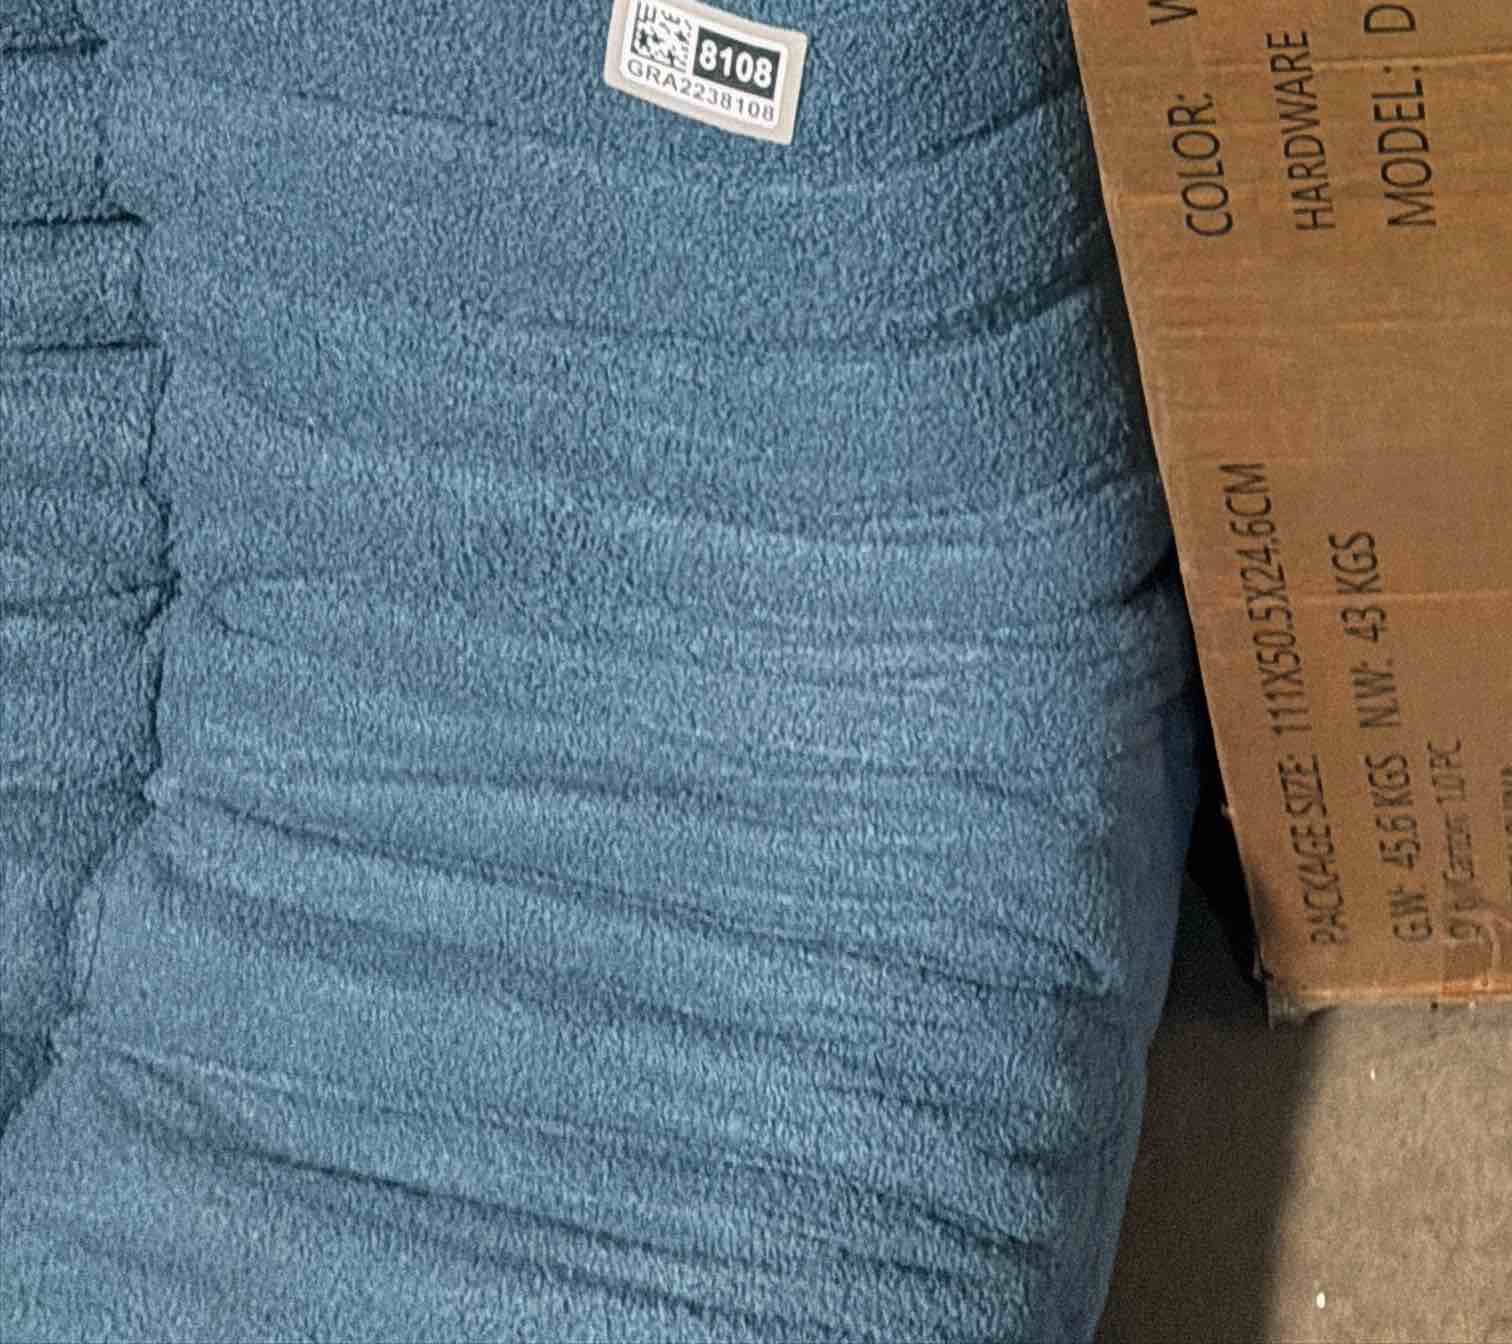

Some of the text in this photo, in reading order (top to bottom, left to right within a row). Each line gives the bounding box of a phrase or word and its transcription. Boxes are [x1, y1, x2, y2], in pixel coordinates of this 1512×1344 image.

[626, 58, 776, 123] GRA2238108
[698, 38, 774, 89] 8108
[1266, 31, 1336, 231] HARDWARE
[1372, 64, 1437, 228] MODEL:
[1168, 92, 1232, 237] COLOR:
[1328, 530, 1383, 594] KGS
[1219, 462, 1313, 737] 111X50.5X24.6CM
[1340, 606, 1388, 643] 43
[1364, 753, 1413, 807] KGS
[1376, 815, 1422, 869] 45.6
[1291, 825, 1350, 945] PACKAGE
